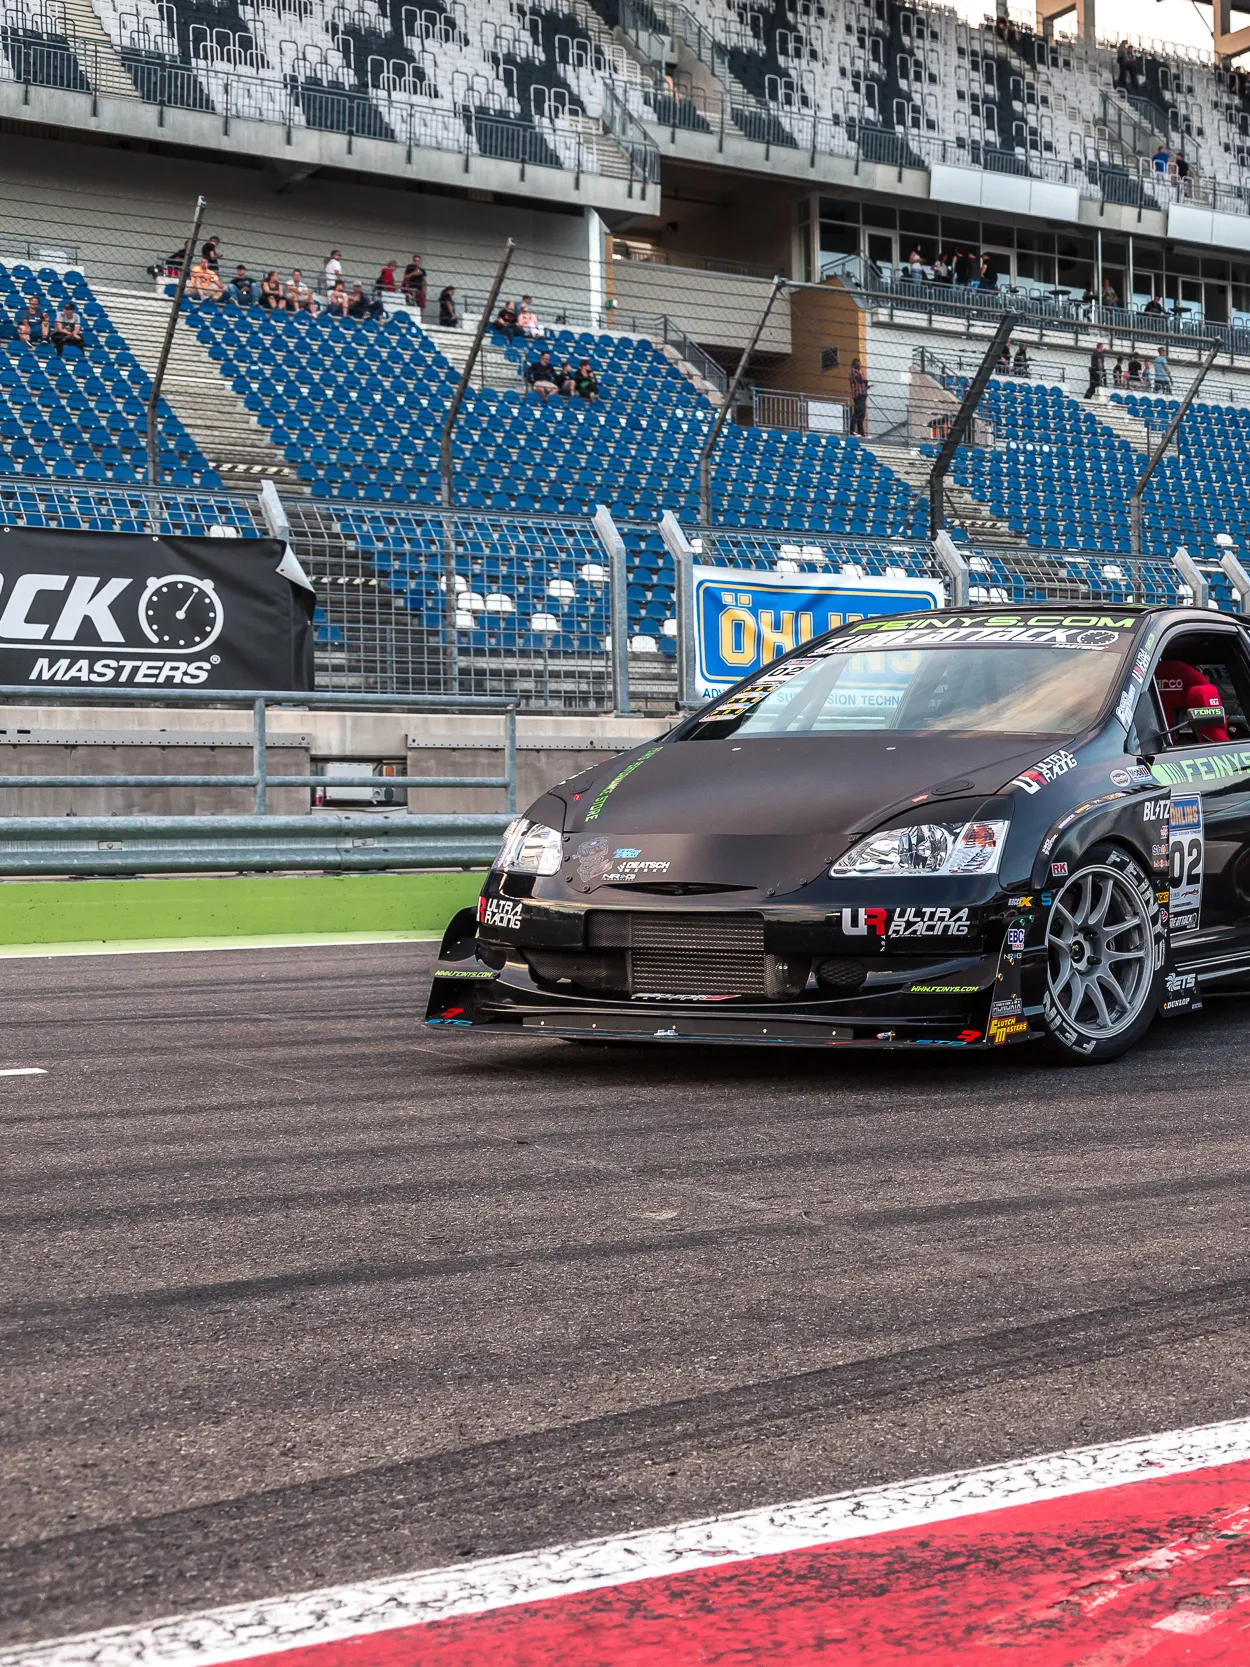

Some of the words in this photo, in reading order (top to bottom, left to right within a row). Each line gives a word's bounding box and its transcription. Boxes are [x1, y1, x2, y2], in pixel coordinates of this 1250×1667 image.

[0, 574, 133, 643] CK
[848, 615, 1136, 634] FEINYS.COM
[28, 657, 211, 684] MASTERS
[768, 667, 806, 677] 02
[1157, 679, 1183, 688] arco
[1033, 750, 1074, 773] ULTRA
[1044, 755, 1078, 782] RACING
[1170, 838, 1202, 889] 02
[487, 899, 522, 915] ULTRA
[484, 912, 521, 930] RACING
[842, 908, 886, 935] UR
[894, 908, 968, 921] ULTRA
[888, 921, 970, 935] RACING
[1008, 930, 1024, 943] EBC
[990, 1018, 1016, 1035] CLUTCH
[995, 1023, 1027, 1043] MASTERS
